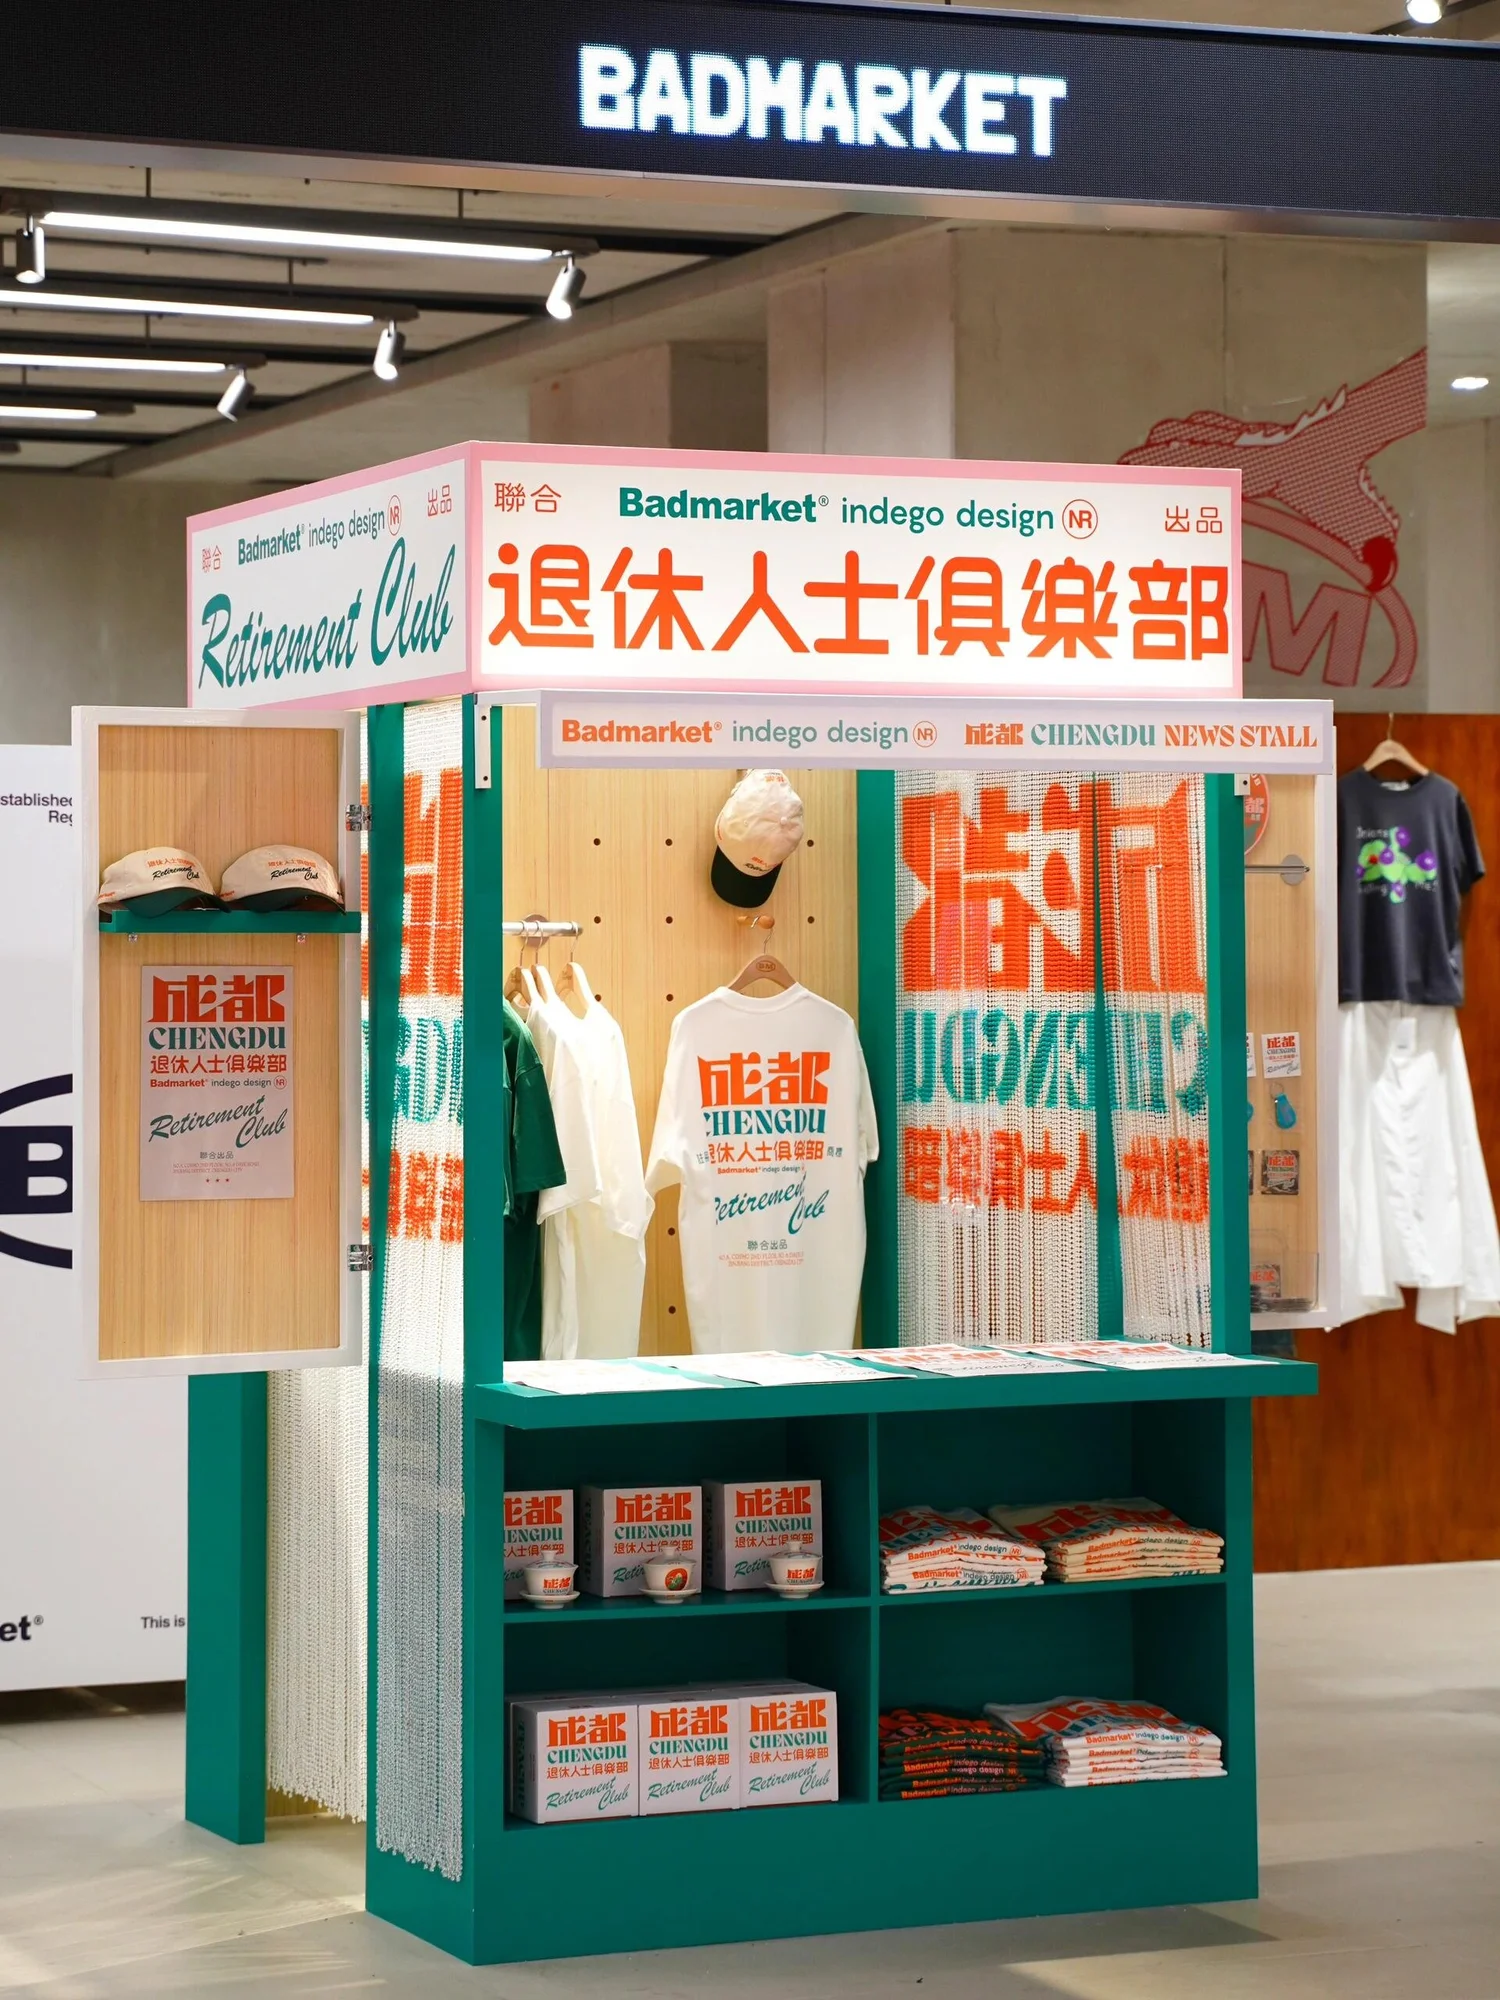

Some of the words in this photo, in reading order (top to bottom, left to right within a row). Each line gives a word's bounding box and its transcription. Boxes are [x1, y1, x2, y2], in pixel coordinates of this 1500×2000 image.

[578, 43, 1068, 158] BADMARKET
[494, 482, 562, 513] 聯合
[842, 497, 944, 534] indego
[956, 500, 1054, 537] design
[1165, 505, 1223, 534] 出品
[201, 545, 222, 573] 聯合
[308, 518, 345, 549] indego
[349, 508, 385, 540] design
[427, 485, 452, 517] 出品
[198, 588, 362, 689] Retirement
[371, 537, 456, 666] Club
[488, 542, 1228, 660] 退休人士俱樂部
[732, 720, 817, 749] indego
[828, 720, 908, 750] design
[964, 723, 1024, 745] 成都
[1031, 723, 1156, 747] CHENGDU
[1164, 724, 1235, 747] NEWS
[1239, 724, 1318, 748] STALL
[270, 867, 311, 880] Retirement
[146, 974, 285, 1023] 成都
[148, 1026, 286, 1050] CHENGDU
[150, 1054, 287, 1074] 退休人士俱樂部
[211, 1079, 240, 1088] indego
[243, 1079, 271, 1088] design
[697, 1052, 830, 1108] 成都
[149, 1095, 265, 1142] Retirement
[235, 1108, 288, 1148] Club
[613, 1492, 691, 1523] 成都
[734, 1486, 811, 1518] 成都
[614, 1523, 692, 1540] CHENGDU
[735, 1517, 812, 1534] CHENGDU
[958, 1543, 981, 1551] indego
[984, 1543, 1007, 1553] design
[141, 1616, 170, 1628] This
[174, 1615, 186, 1627] is
[648, 1705, 728, 1738] 成都
[749, 1699, 827, 1732] 成都
[547, 1713, 626, 1747] 成都
[749, 1731, 827, 1749] CHENGDU
[1161, 1734, 1184, 1743] design
[547, 1745, 627, 1764] CHENGDU
[649, 1737, 728, 1755] CHENGDU
[749, 1747, 829, 1764] 退休人士俱樂部
[547, 1761, 628, 1779] 退休人士俱樂部
[649, 1753, 730, 1770] 退休人士俱樂部
[647, 1768, 718, 1800] Retirement
[700, 1776, 731, 1802] Club
[748, 1761, 817, 1794] Retirement
[799, 1769, 831, 1795] Club
[545, 1776, 616, 1811] Retirement
[598, 1784, 630, 1811] Club
